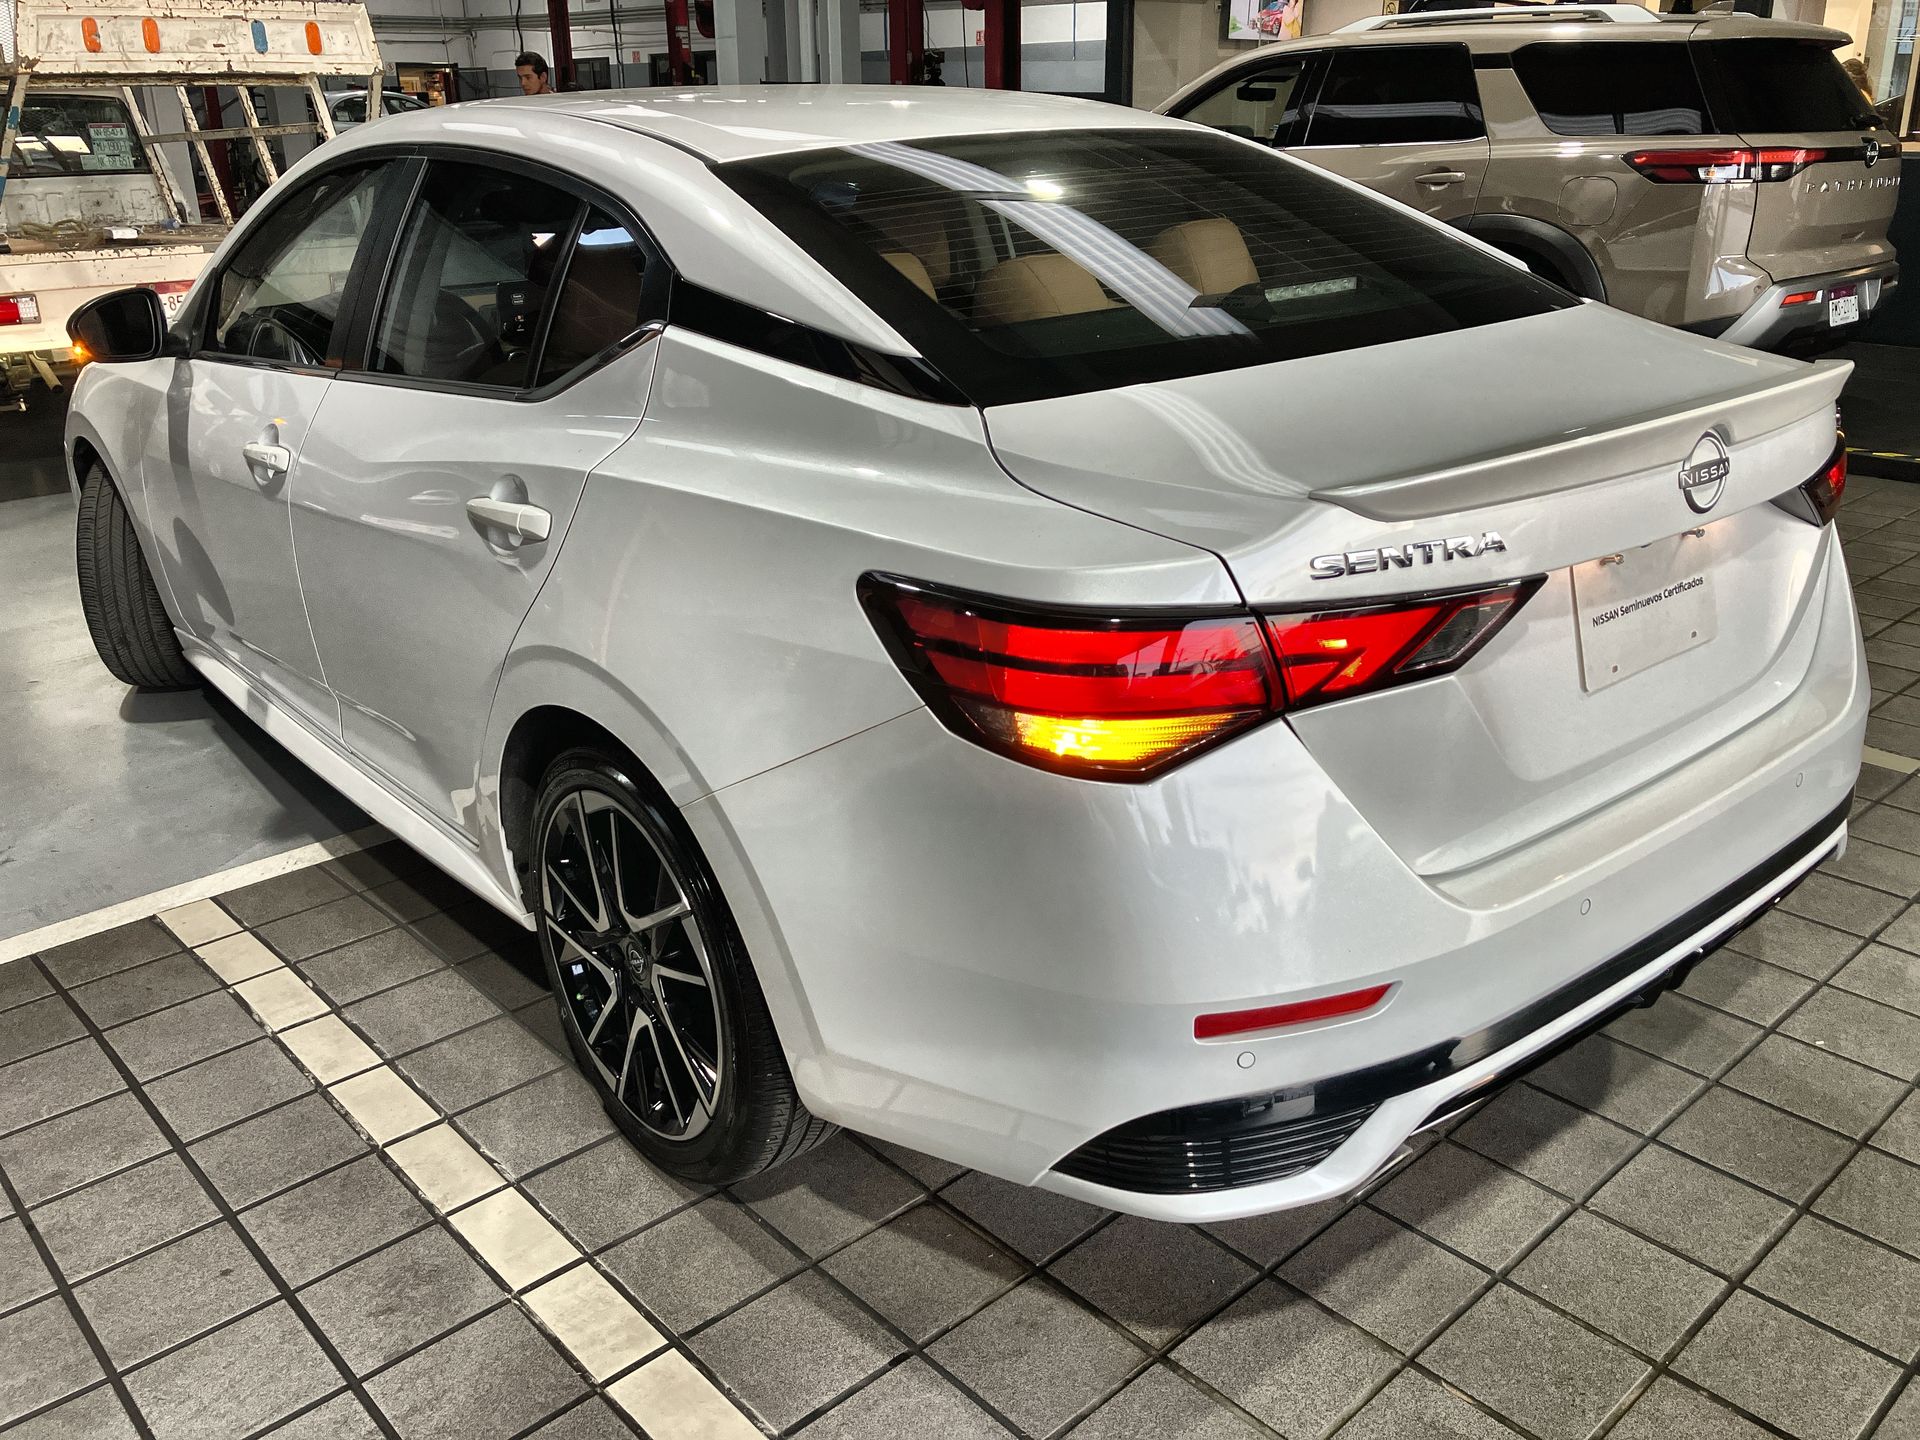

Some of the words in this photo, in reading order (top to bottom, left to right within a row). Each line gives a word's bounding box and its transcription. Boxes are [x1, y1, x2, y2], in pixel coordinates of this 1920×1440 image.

[1310, 531, 1508, 581] SENTRA
[1592, 608, 1620, 628] NISSAN
[1620, 592, 1662, 616] Seminuevos
[1663, 576, 1704, 599] Certificados
